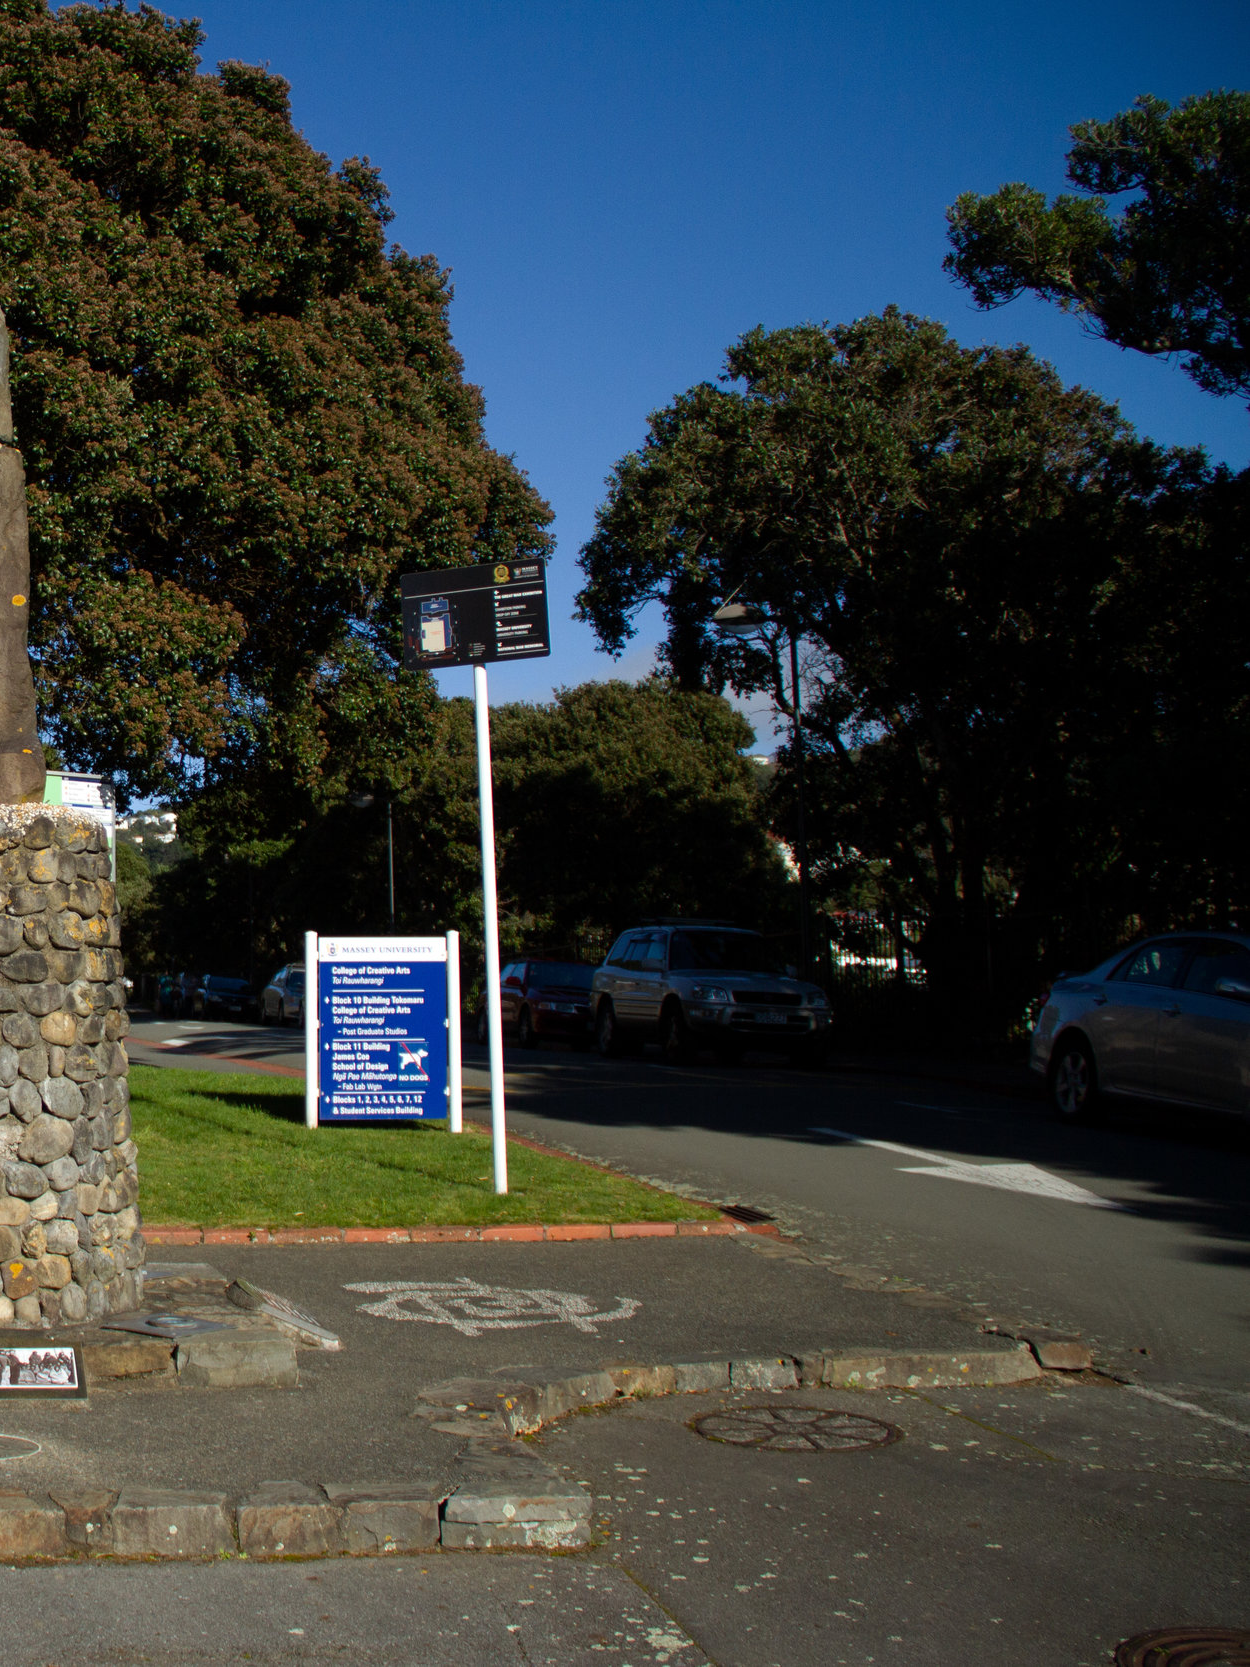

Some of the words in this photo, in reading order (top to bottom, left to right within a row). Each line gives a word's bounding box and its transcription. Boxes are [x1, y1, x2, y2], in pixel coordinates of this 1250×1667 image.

[332, 966, 357, 975] College
[358, 966, 366, 974] of
[367, 966, 395, 974] Creative
[396, 966, 410, 974] Arts
[332, 996, 351, 1004] Block
[354, 996, 362, 1004] 10
[363, 996, 390, 1005] Building
[391, 996, 424, 1004] Tokomaru
[332, 1006, 357, 1015] College
[359, 1006, 366, 1014] of
[367, 1006, 395, 1014] Creative
[397, 1006, 411, 1014] Arts
[385, 1027, 408, 1035] Studios
[363, 1043, 390, 1051] Building
[366, 1063, 388, 1071] Design
[357, 1096, 363, 1104] 1,
[365, 1096, 372, 1104] 2,
[374, 1096, 379, 1104] 3,
[381, 1096, 387, 1104] 4,
[389, 1096, 396, 1104] 5,
[397, 1096, 404, 1104] 6,
[406, 1096, 412, 1104] 7,
[396, 1107, 423, 1115] Building
